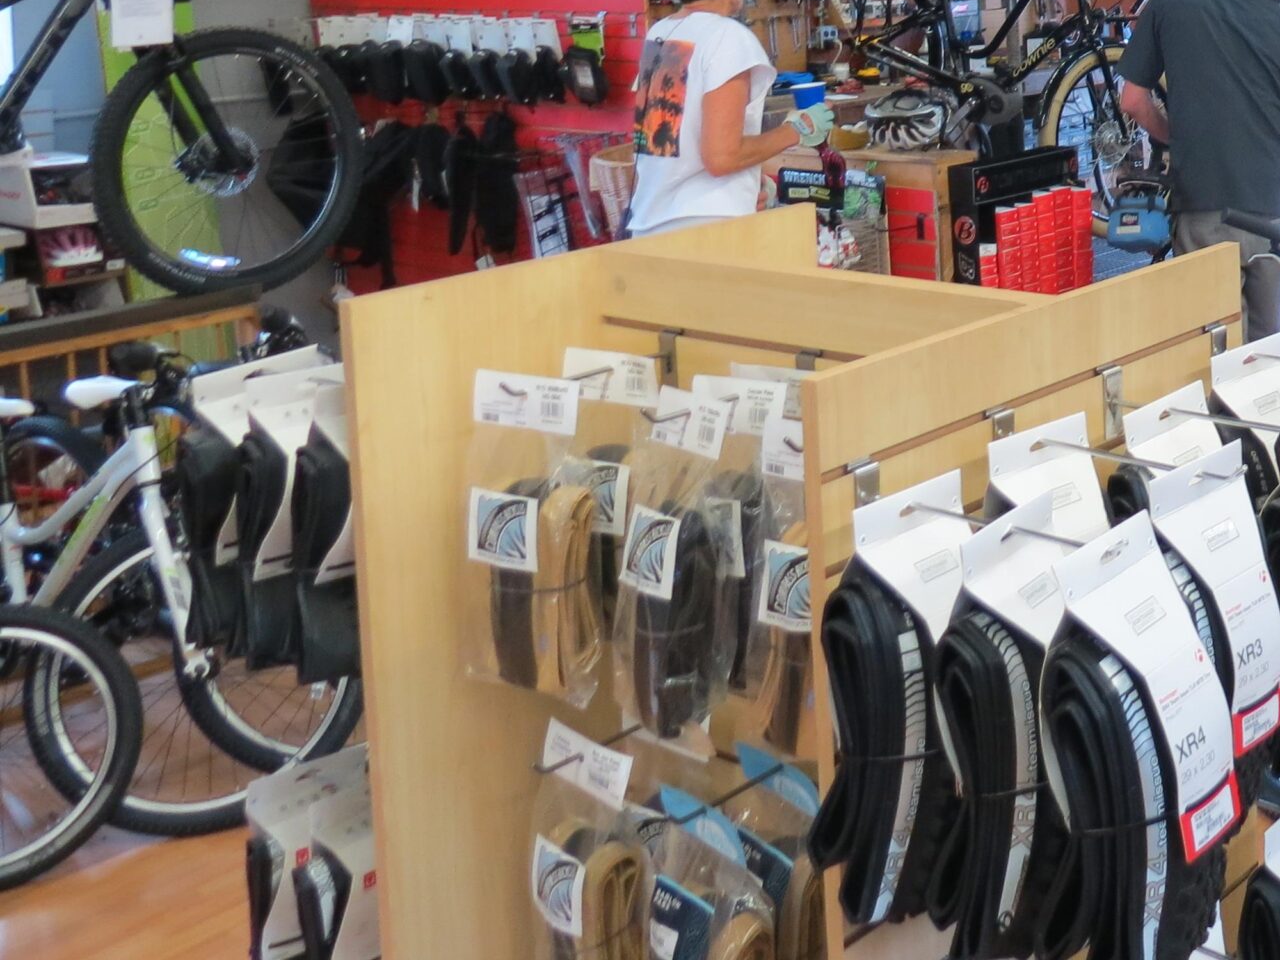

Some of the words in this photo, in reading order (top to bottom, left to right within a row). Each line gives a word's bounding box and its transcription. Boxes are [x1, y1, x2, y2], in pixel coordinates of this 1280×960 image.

[1237, 638, 1264, 669] XR3
[1022, 680, 1036, 728] issue
[1026, 727, 1038, 771] team
[1175, 725, 1207, 764] XR4
[907, 784, 921, 823] team
[1144, 851, 1167, 925] XR4
